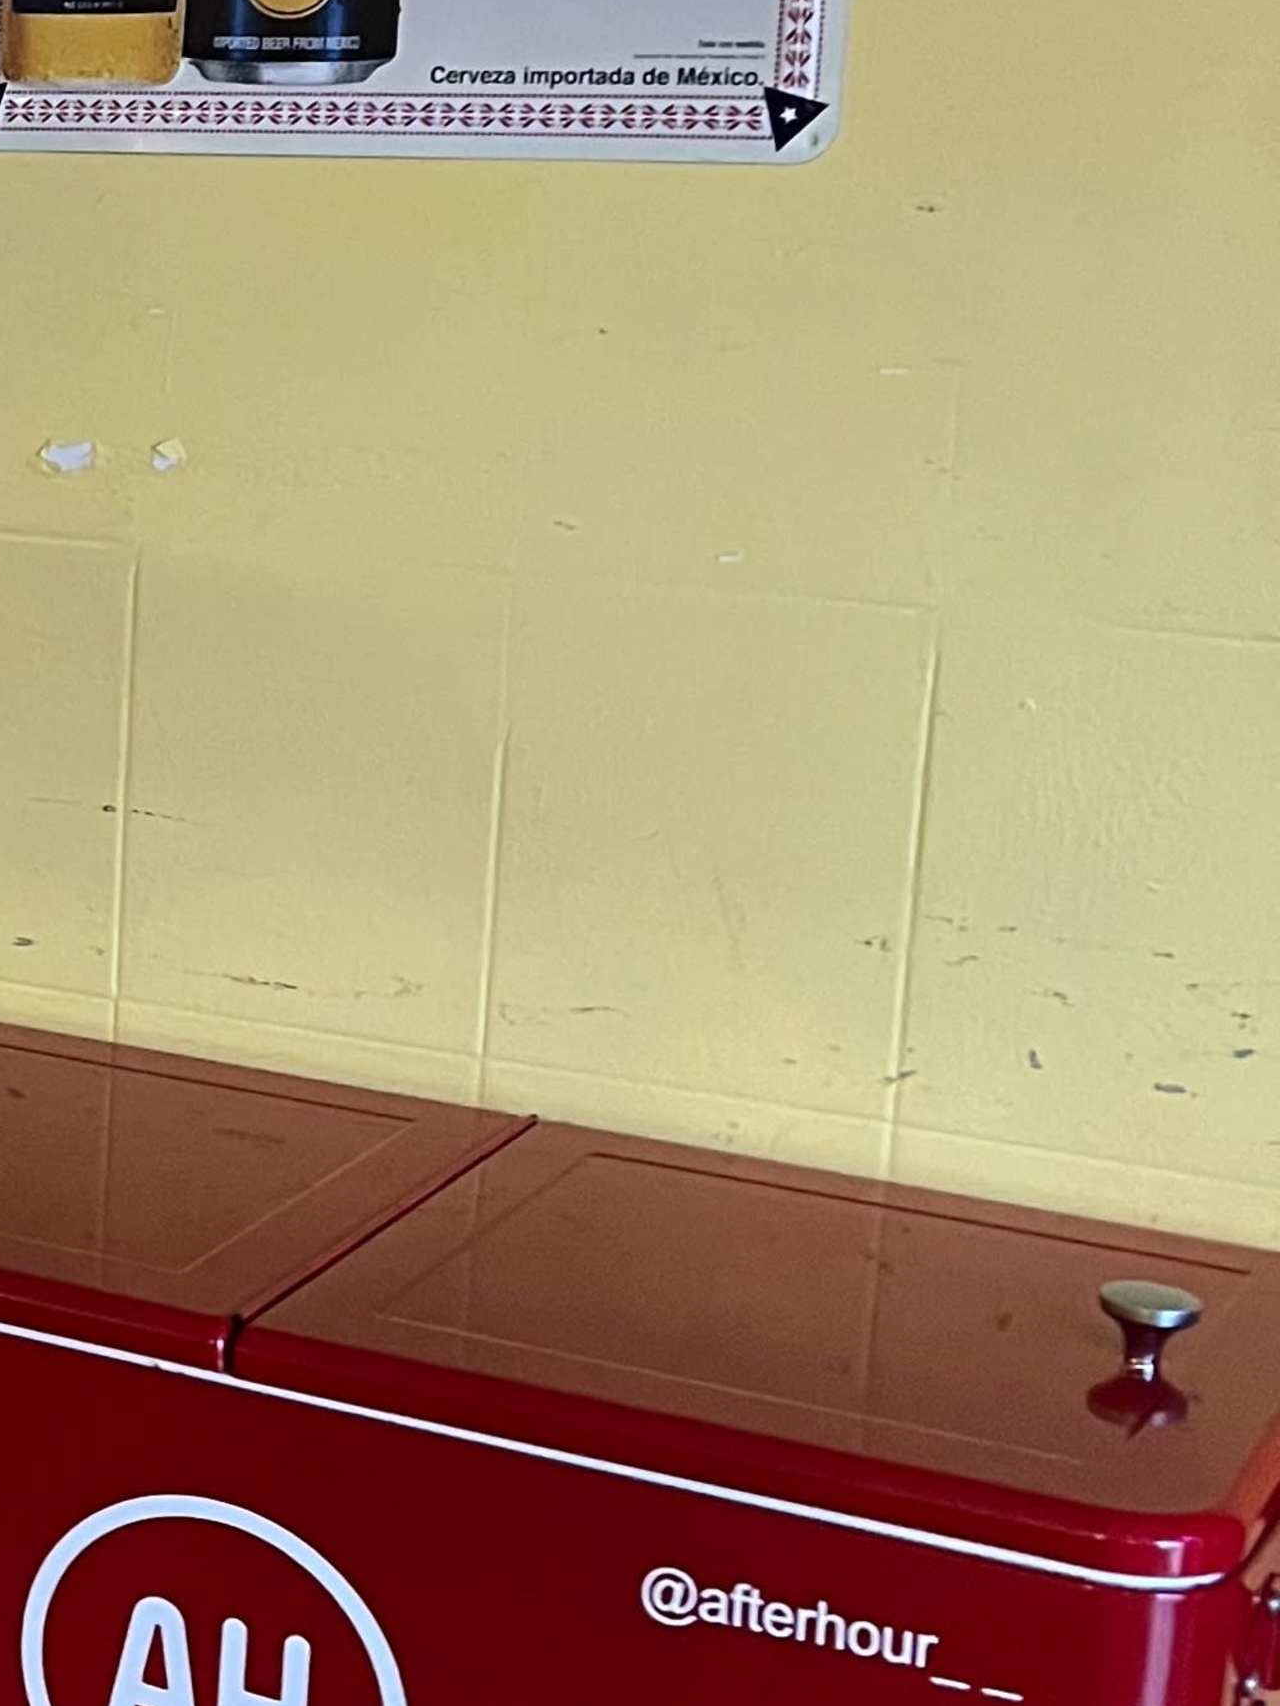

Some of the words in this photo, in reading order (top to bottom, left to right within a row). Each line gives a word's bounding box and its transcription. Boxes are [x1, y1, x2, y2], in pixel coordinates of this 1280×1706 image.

[429, 66, 516, 87] Cerveza
[523, 66, 635, 91] importada
[642, 67, 670, 87] de
[676, 65, 765, 88] México.
